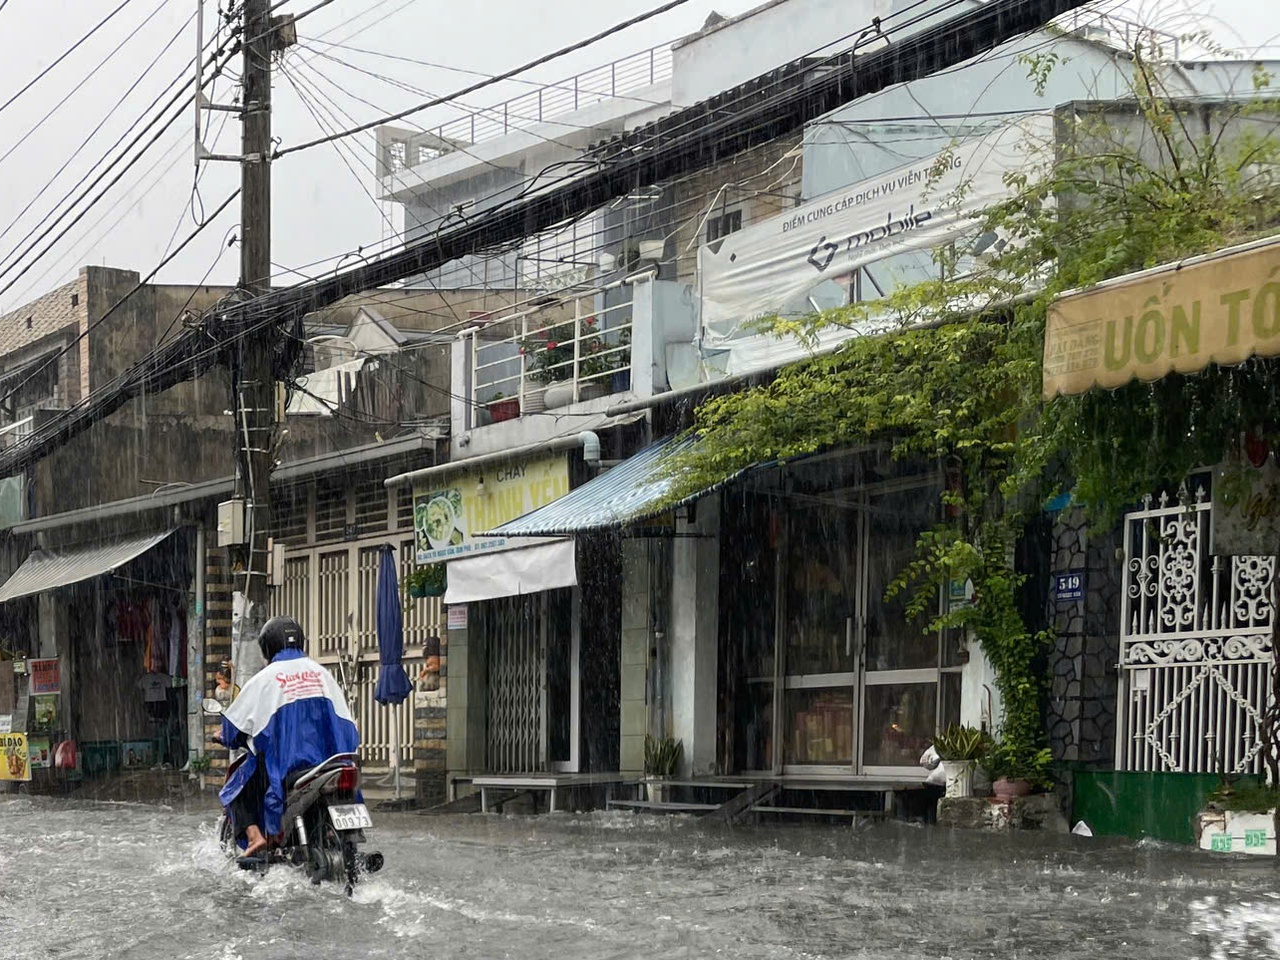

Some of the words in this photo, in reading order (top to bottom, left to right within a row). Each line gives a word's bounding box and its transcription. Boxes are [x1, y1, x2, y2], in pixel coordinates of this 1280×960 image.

[808, 206, 834, 223] CUNG
[846, 204, 933, 251] mobile
[1103, 281, 1202, 372] UỐN
[496, 462, 529, 483] CHAY
[1058, 576, 1080, 590] 549
